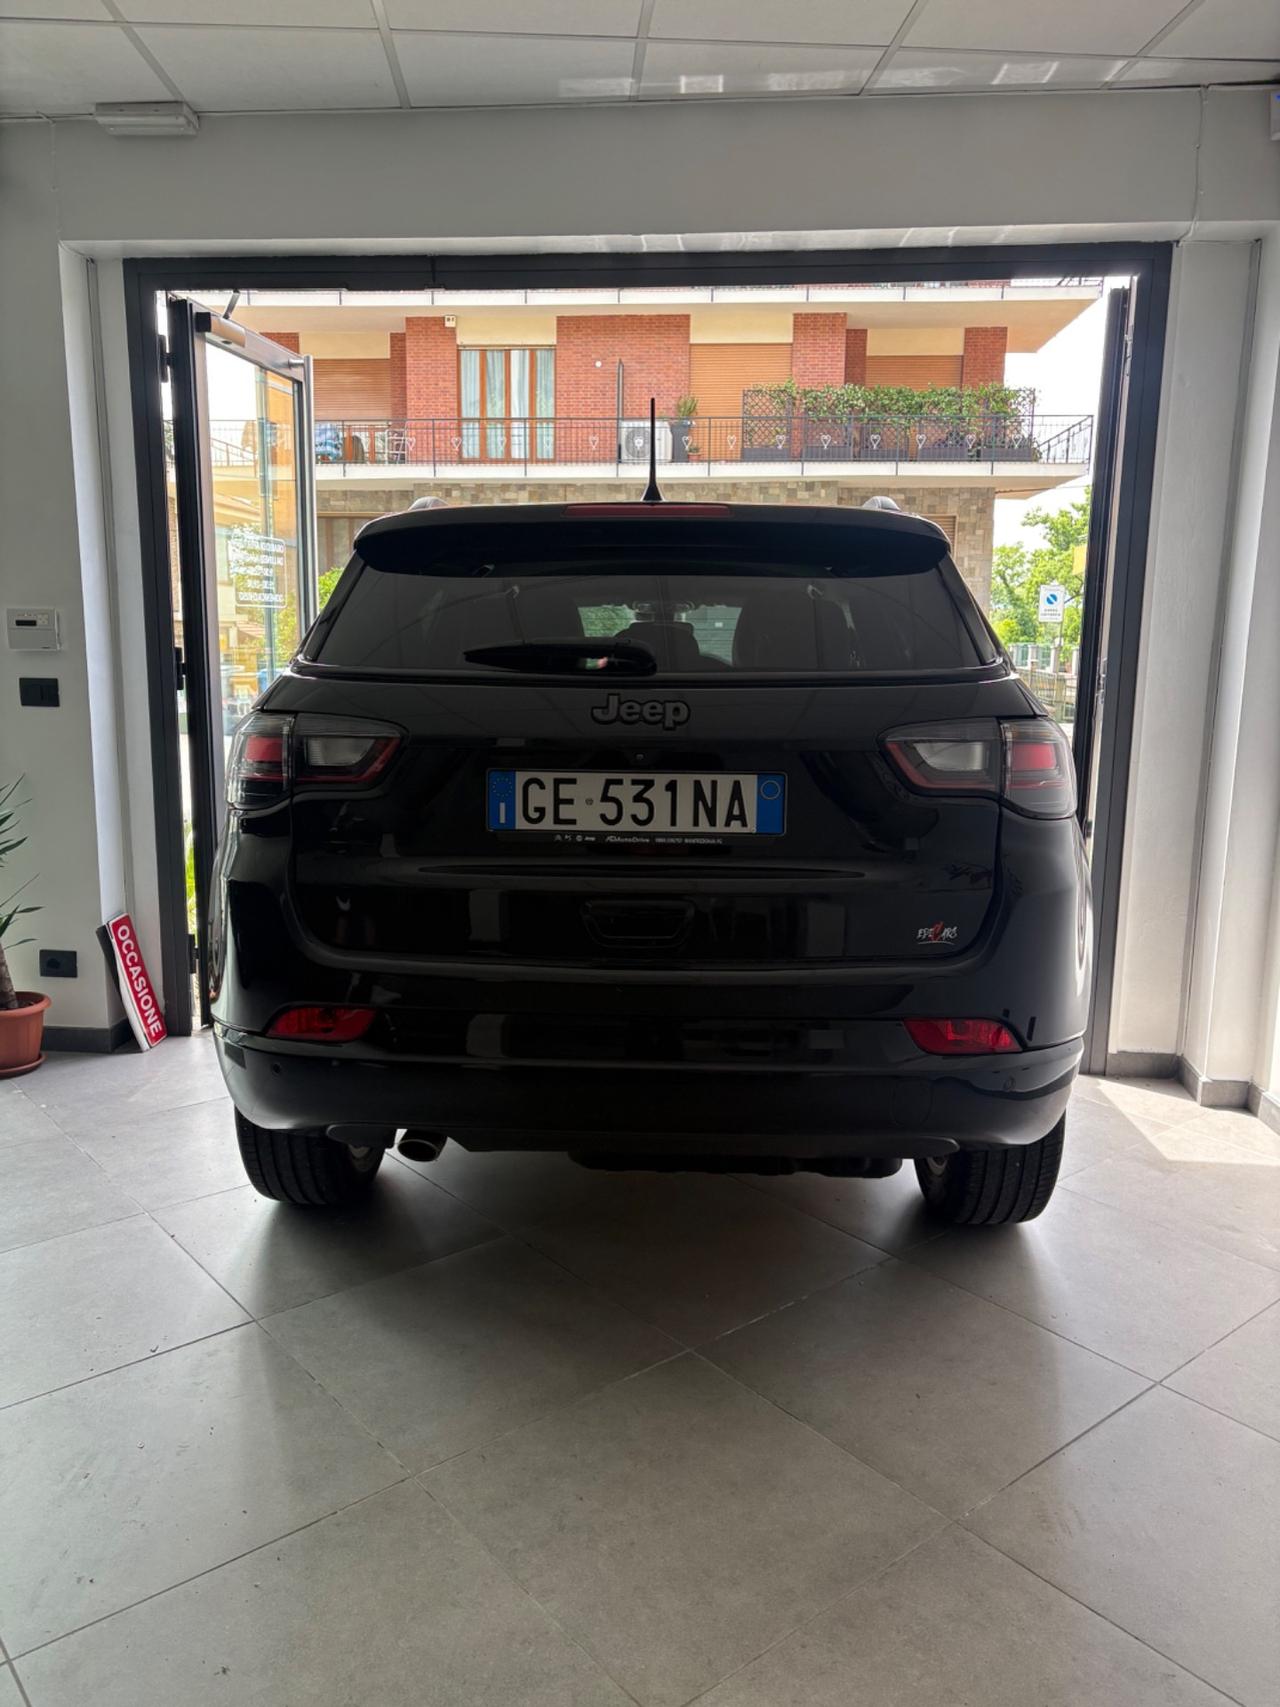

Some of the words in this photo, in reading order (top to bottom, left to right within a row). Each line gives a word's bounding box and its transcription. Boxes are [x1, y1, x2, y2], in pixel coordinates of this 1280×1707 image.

[591, 693, 690, 731] Jeep
[522, 777, 577, 824] GE
[600, 778, 748, 827] 531NA
[117, 924, 163, 1038] OCCASIONE
